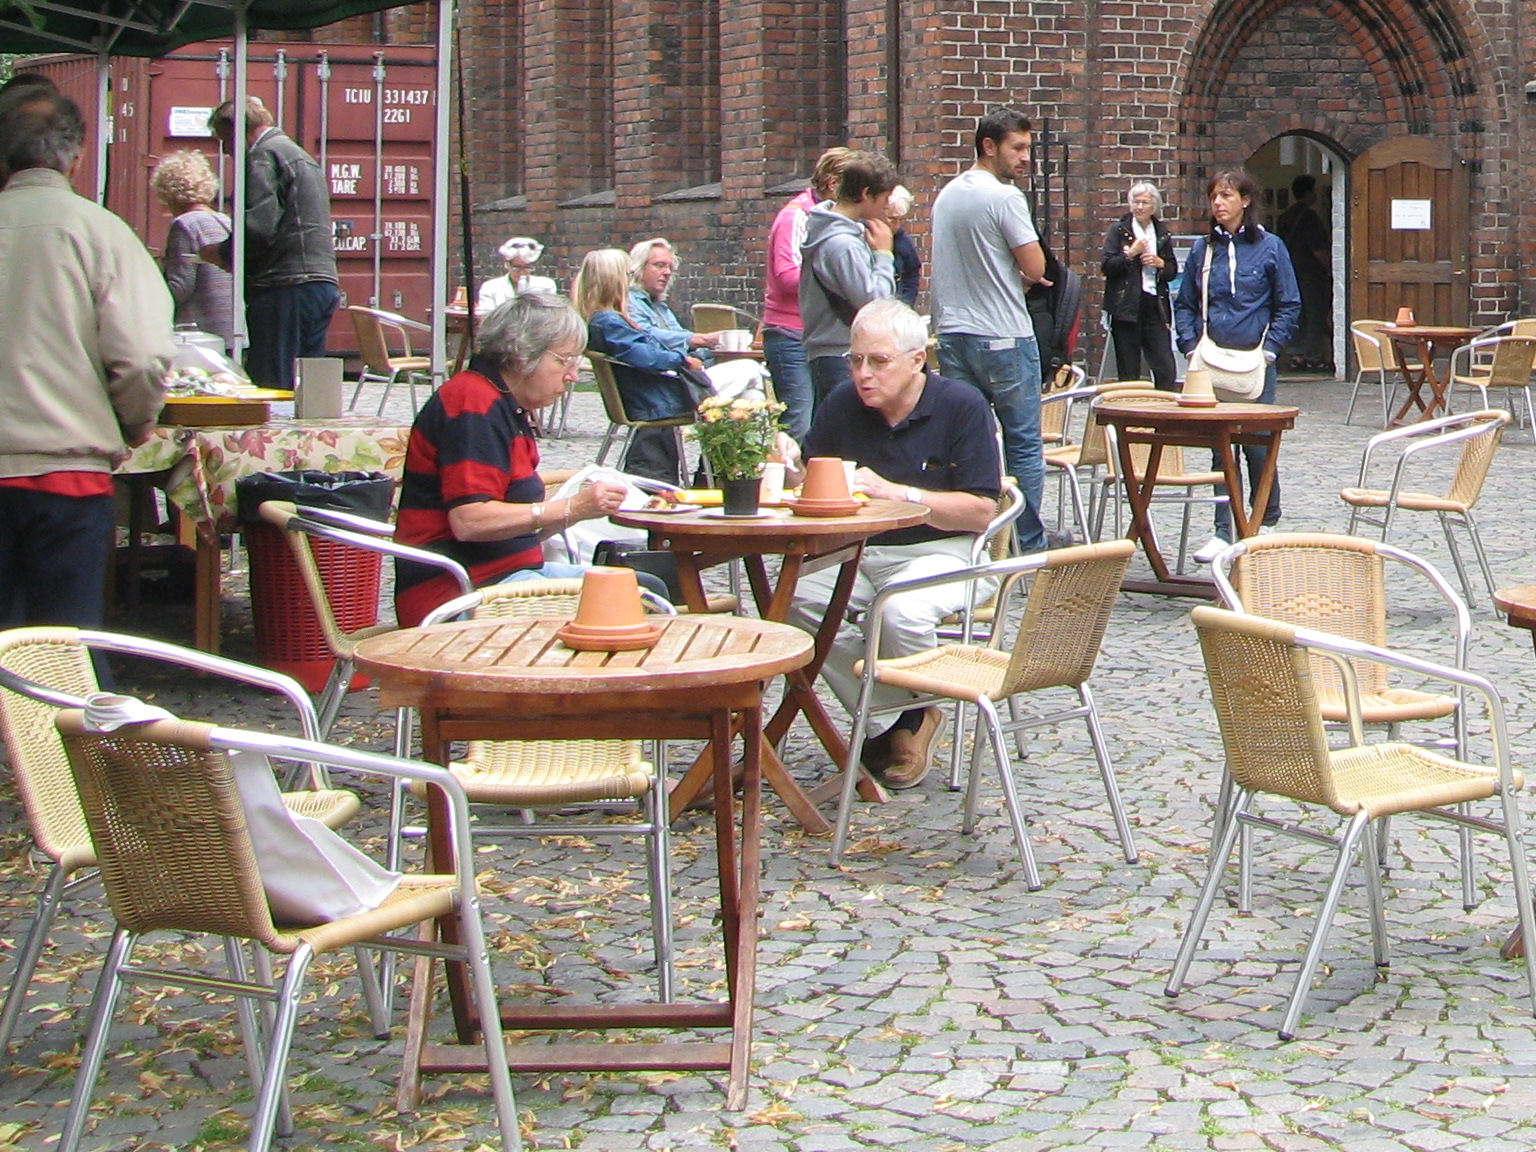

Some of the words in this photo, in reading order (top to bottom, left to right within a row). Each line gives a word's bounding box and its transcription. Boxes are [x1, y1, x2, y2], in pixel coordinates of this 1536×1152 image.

[344, 88, 372, 104] TCIU
[384, 89, 429, 105] 331437
[331, 163, 362, 179] M.G.W.
[331, 179, 357, 195] TARE
